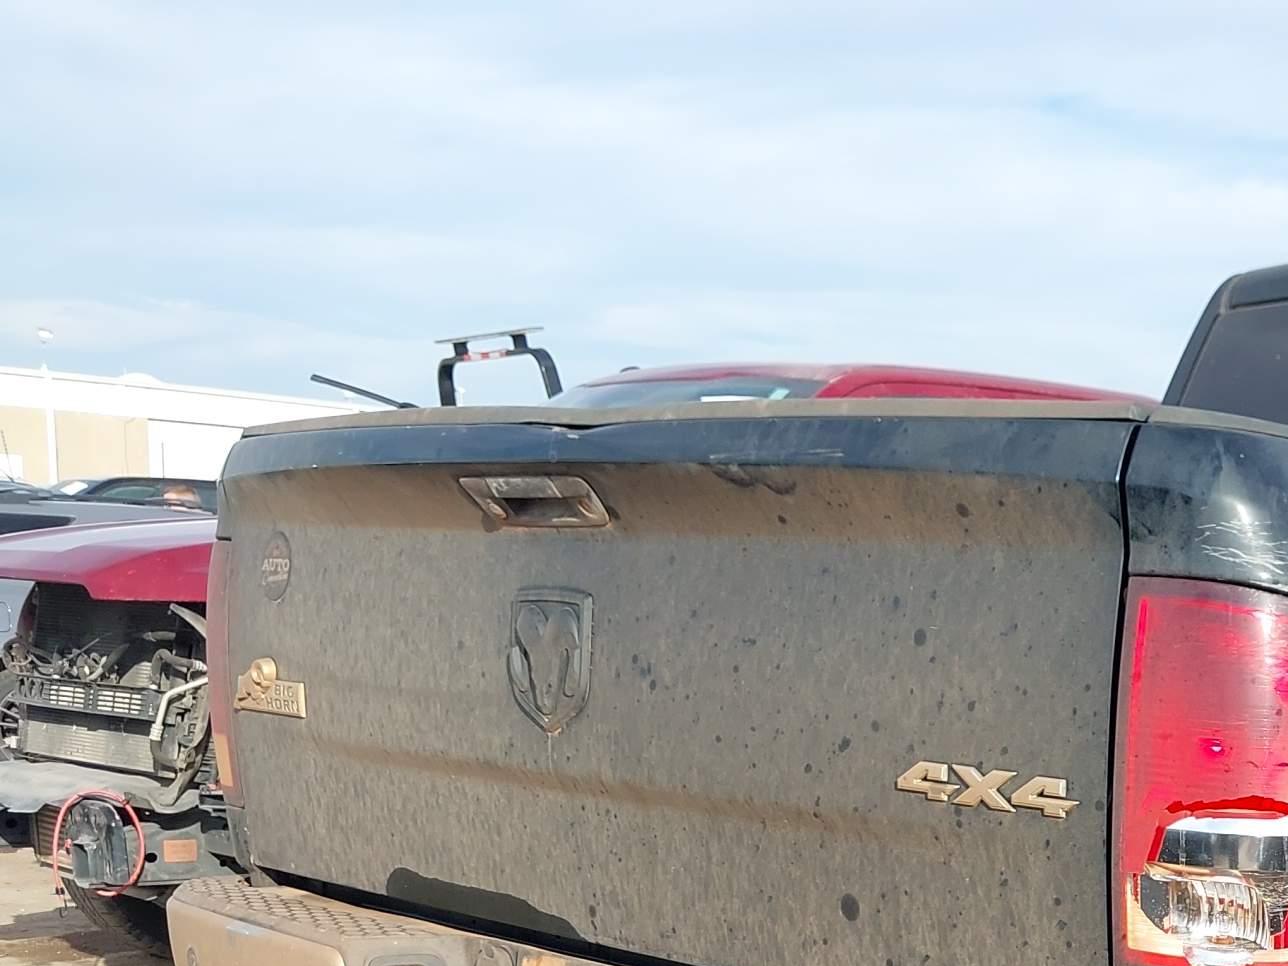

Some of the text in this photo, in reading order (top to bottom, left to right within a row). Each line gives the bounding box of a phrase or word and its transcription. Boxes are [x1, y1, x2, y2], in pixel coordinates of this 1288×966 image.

[261, 558, 290, 571] AUTO
[273, 684, 294, 699] BIG
[265, 696, 300, 713] HORN
